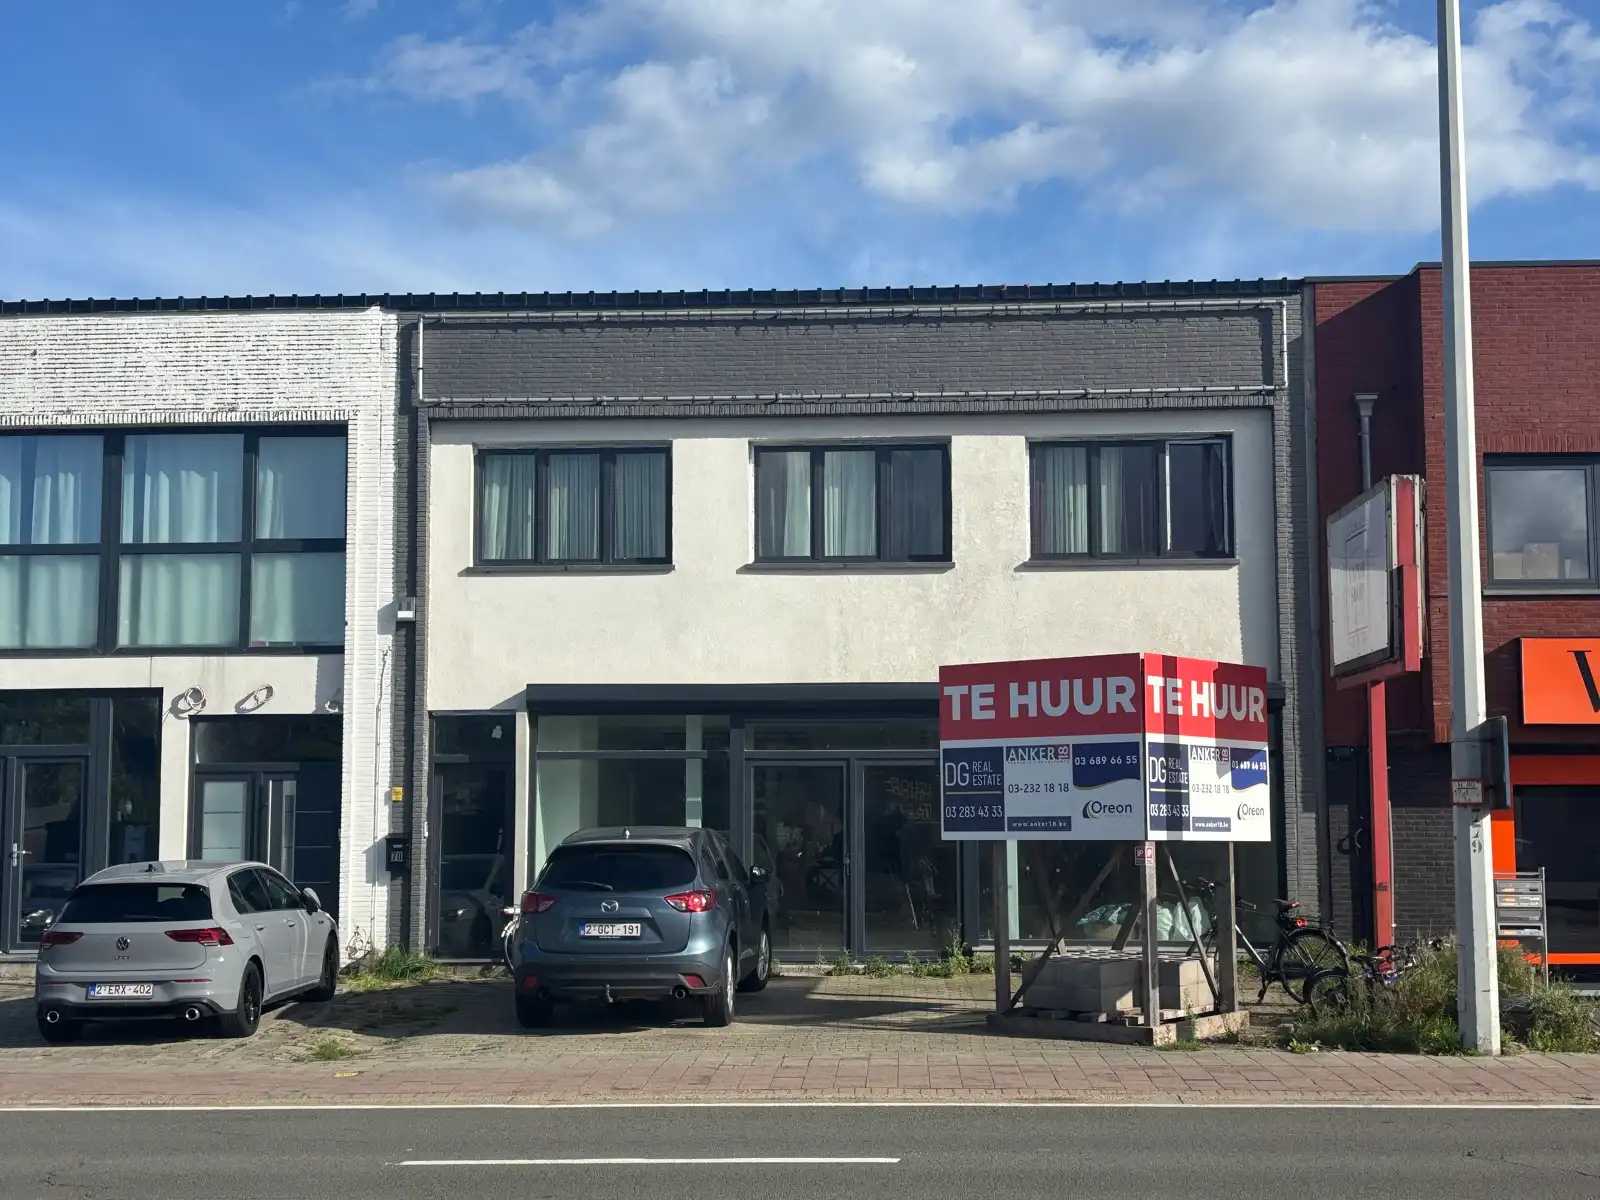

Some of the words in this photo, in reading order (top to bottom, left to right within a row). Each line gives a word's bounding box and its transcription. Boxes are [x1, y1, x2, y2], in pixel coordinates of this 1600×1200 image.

[943, 684, 995, 721] TE
[1009, 676, 1136, 719] HUUR
[1147, 675, 1183, 716] TE
[1190, 680, 1265, 723] HUUR
[1008, 746, 1055, 761] ANKER
[1074, 757, 1086, 765] 03
[1089, 756, 1107, 765] 689
[1110, 756, 1122, 765] 66
[1126, 755, 1138, 764] 55
[1191, 746, 1220, 761] ANKER
[972, 761, 993, 773] REAL
[1149, 756, 1167, 783] DG
[1168, 757, 1183, 770] REAL
[945, 762, 970, 787] DG
[972, 773, 1002, 786] ESTATE
[1168, 772, 1189, 785] ESTATE
[1008, 783, 1041, 793] 03-232
[1044, 783, 1055, 793] 18
[1058, 782, 1069, 792] 18
[1191, 783, 1213, 794] 03-232
[945, 806, 957, 818] 03
[958, 806, 976, 818] 283
[978, 806, 989, 817] 43
[991, 805, 1003, 818] 33
[1091, 801, 1133, 814] Oreon
[1150, 804, 1159, 817] 03
[1160, 804, 1172, 817] 283
[1173, 805, 1181, 817] 43
[1181, 805, 1190, 818] 33
[1241, 804, 1265, 816] Oreon
